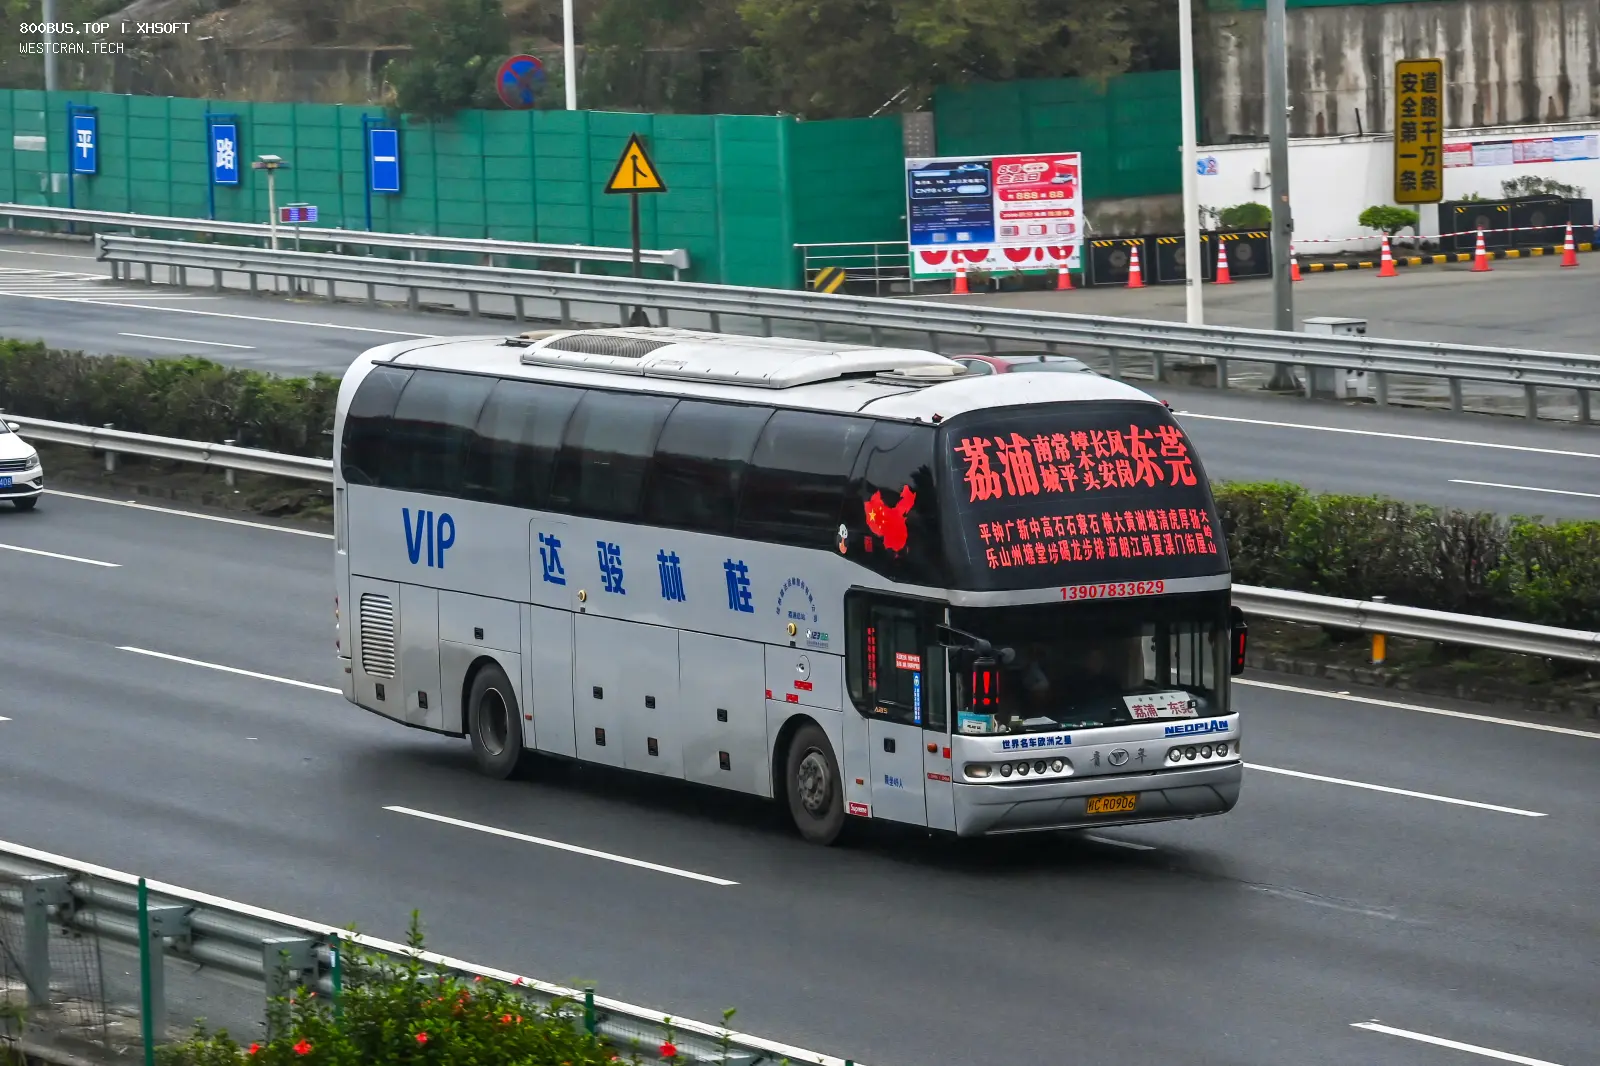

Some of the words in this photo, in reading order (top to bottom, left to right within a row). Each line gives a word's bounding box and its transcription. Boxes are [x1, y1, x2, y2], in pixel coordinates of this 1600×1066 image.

[76, 129, 94, 158] 平
[216, 138, 234, 170] 路
[1400, 72, 1418, 191] 安全第一条
[1420, 72, 1437, 191] 道路千万条
[954, 433, 1040, 502] 荔浦
[1123, 424, 1198, 487] 东莞
[402, 507, 456, 569] VIP
[1060, 580, 1165, 600] 13907833629
[1002, 735, 1072, 750] 世界名车欧洲之星
[850, 804, 867, 814] Supreme
